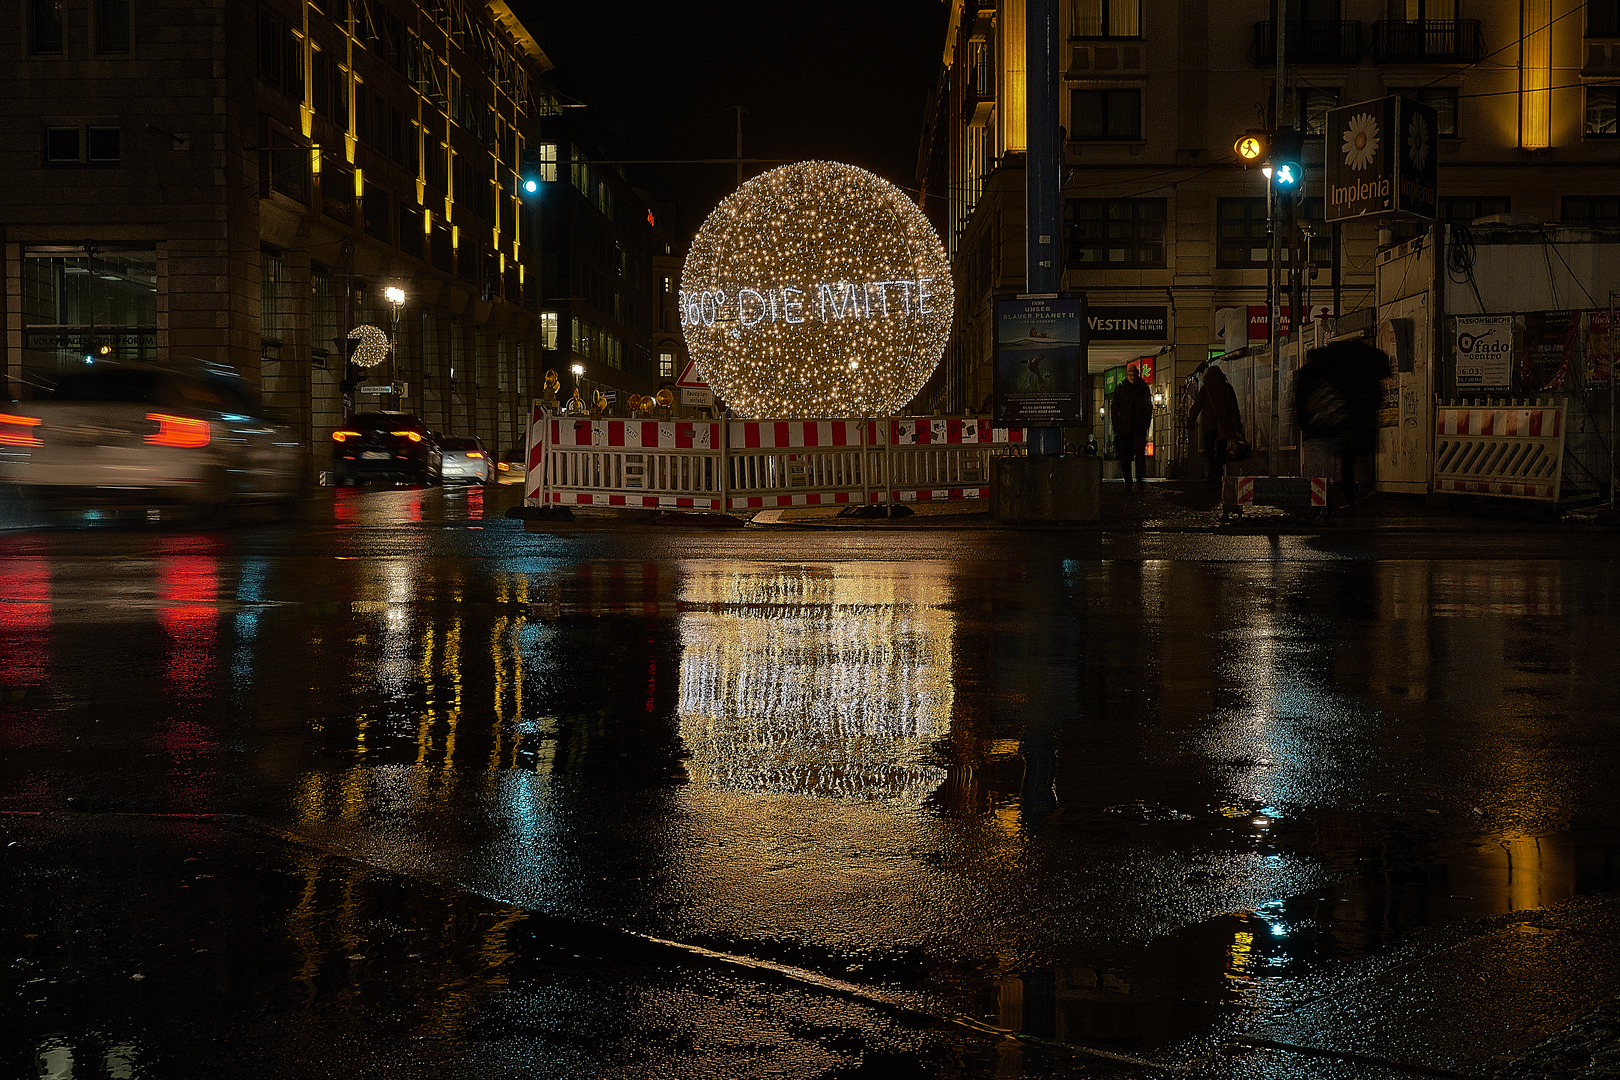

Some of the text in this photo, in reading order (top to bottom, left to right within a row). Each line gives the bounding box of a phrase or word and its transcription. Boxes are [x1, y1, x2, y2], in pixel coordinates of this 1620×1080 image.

[1331, 174, 1390, 209] Implenia
[738, 288, 804, 326] DIE
[820, 278, 934, 322] MITTE
[1458, 316, 1511, 325] PASSIONSKIRCHE
[33, 337, 90, 346] VOLKSWAGEN
[122, 337, 154, 345] FORUM
[1468, 352, 1502, 360] centro
